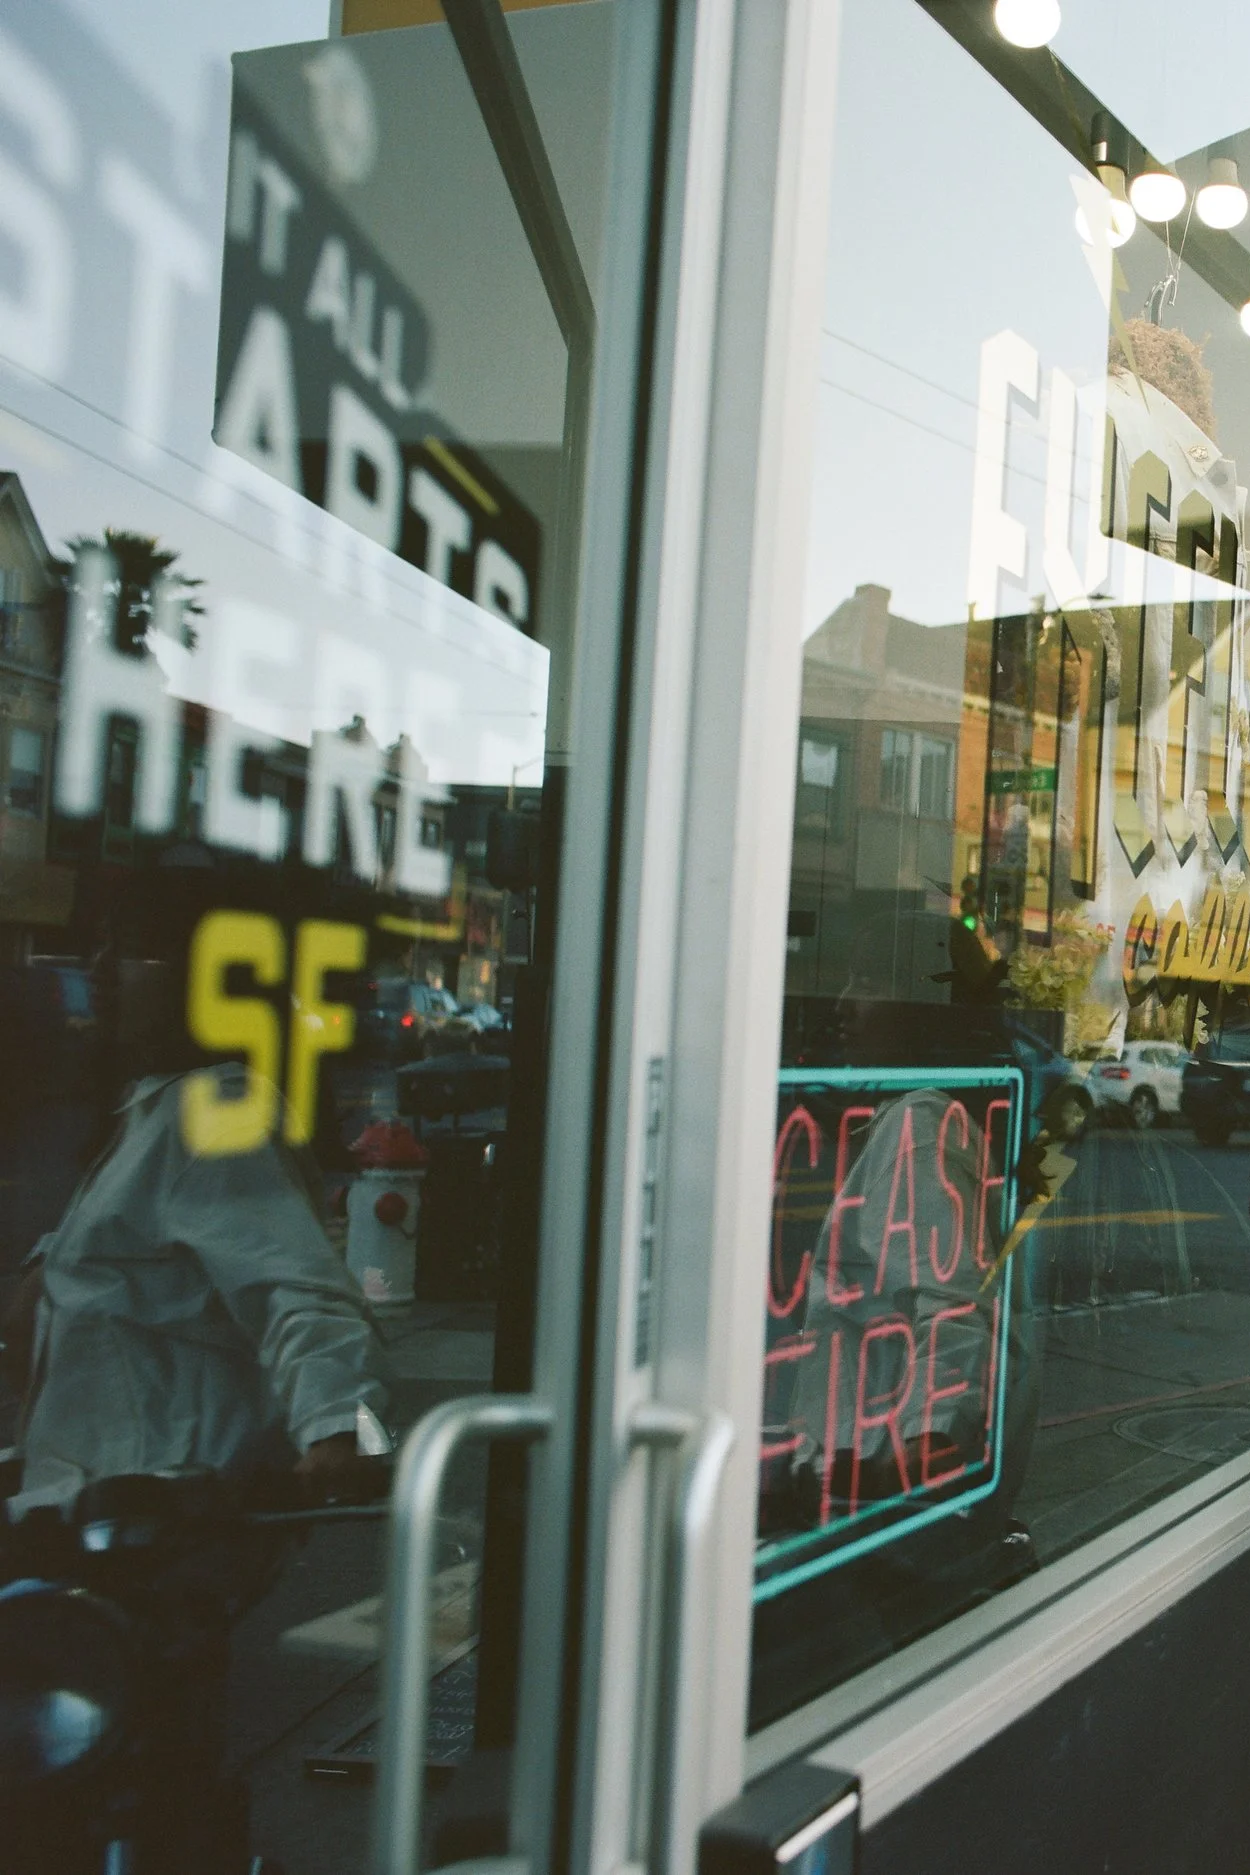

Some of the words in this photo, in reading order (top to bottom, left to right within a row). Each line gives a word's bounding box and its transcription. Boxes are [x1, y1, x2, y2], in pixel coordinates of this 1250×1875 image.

[304, 235, 416, 413] ALL
[53, 538, 458, 897] HERE
[180, 907, 368, 1160] SF
[767, 1099, 1011, 1319] CEASE
